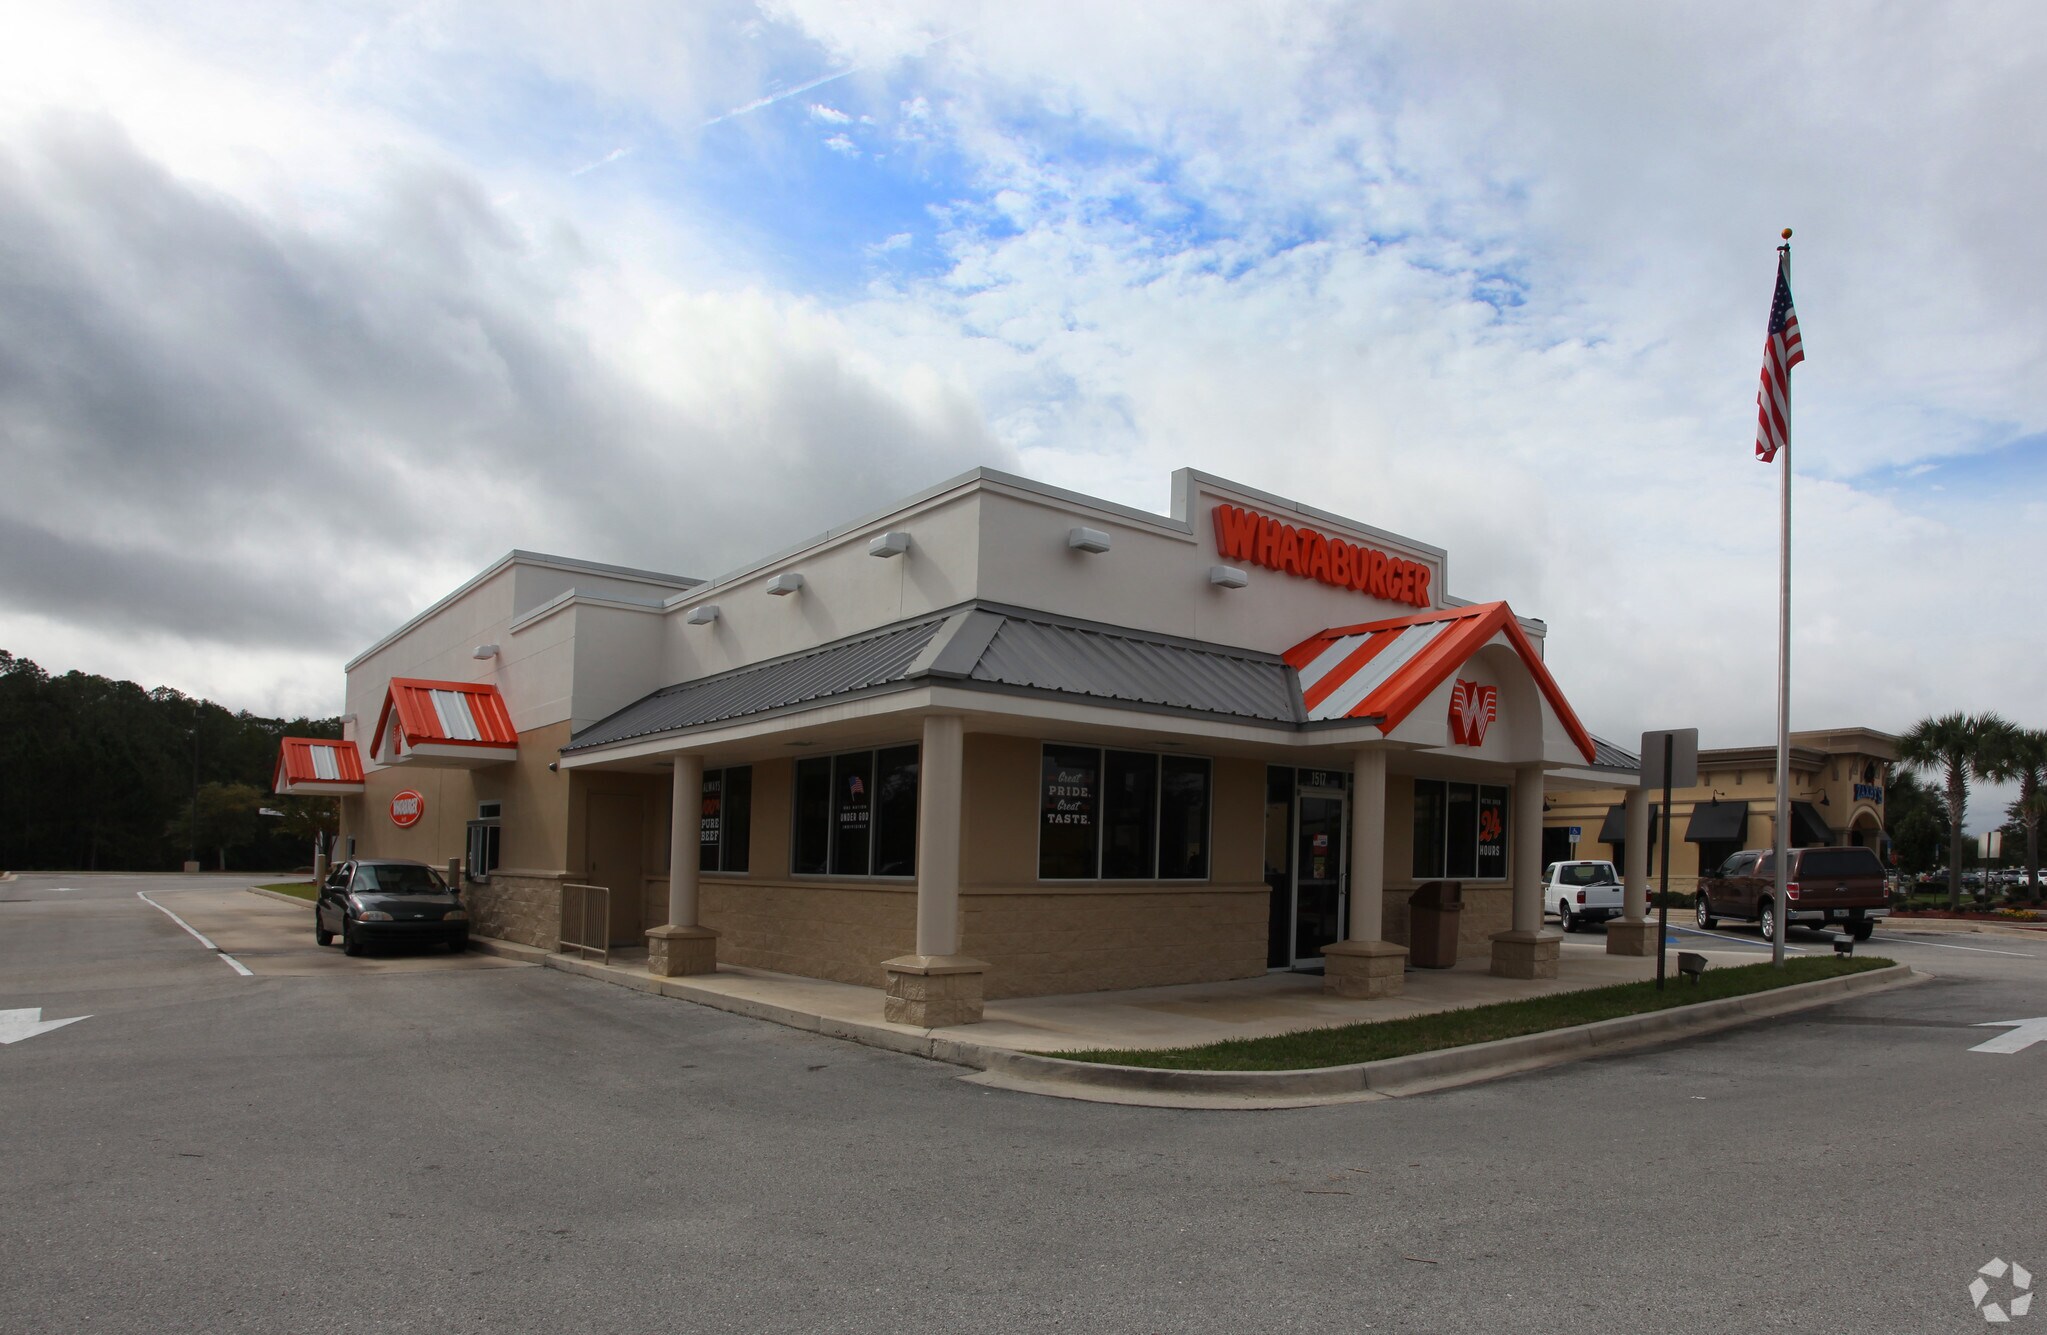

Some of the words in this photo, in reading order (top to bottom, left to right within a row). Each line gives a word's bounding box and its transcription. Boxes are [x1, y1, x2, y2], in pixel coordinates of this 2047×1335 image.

[1212, 504, 1431, 608] WHATABURGER
[1058, 771, 1082, 783] Great
[1311, 771, 1327, 786] 1517
[702, 780, 721, 793] ALWAYS
[1049, 785, 1092, 798] PRIDE.
[1057, 799, 1082, 811] Great
[840, 812, 857, 822] UNDER
[858, 811, 869, 821] GOD
[1047, 813, 1091, 825] TASTE.
[701, 818, 720, 829] PURE
[1480, 806, 1502, 842] 24
[700, 830, 720, 841] BEEF
[1479, 845, 1500, 856] HOURS
